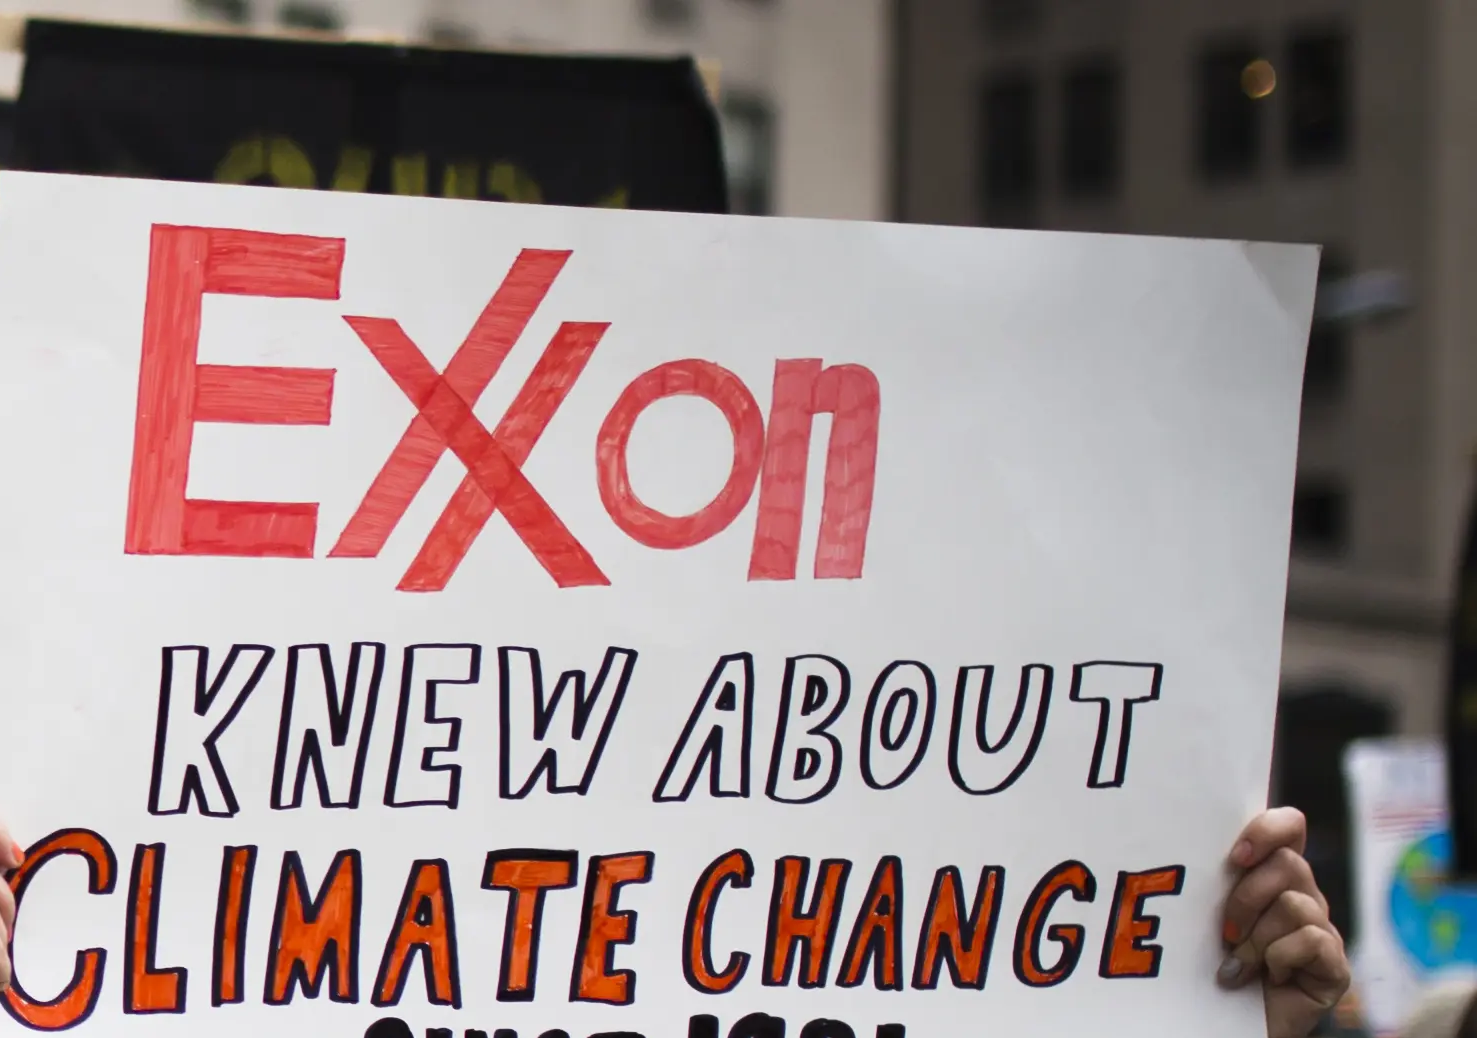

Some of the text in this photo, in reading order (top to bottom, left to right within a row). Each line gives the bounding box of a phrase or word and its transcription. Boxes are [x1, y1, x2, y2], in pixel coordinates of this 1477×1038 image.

[148, 641, 1163, 818] KNEW ABOUT
[2, 827, 1186, 1032] CLIMATE CHANGE
